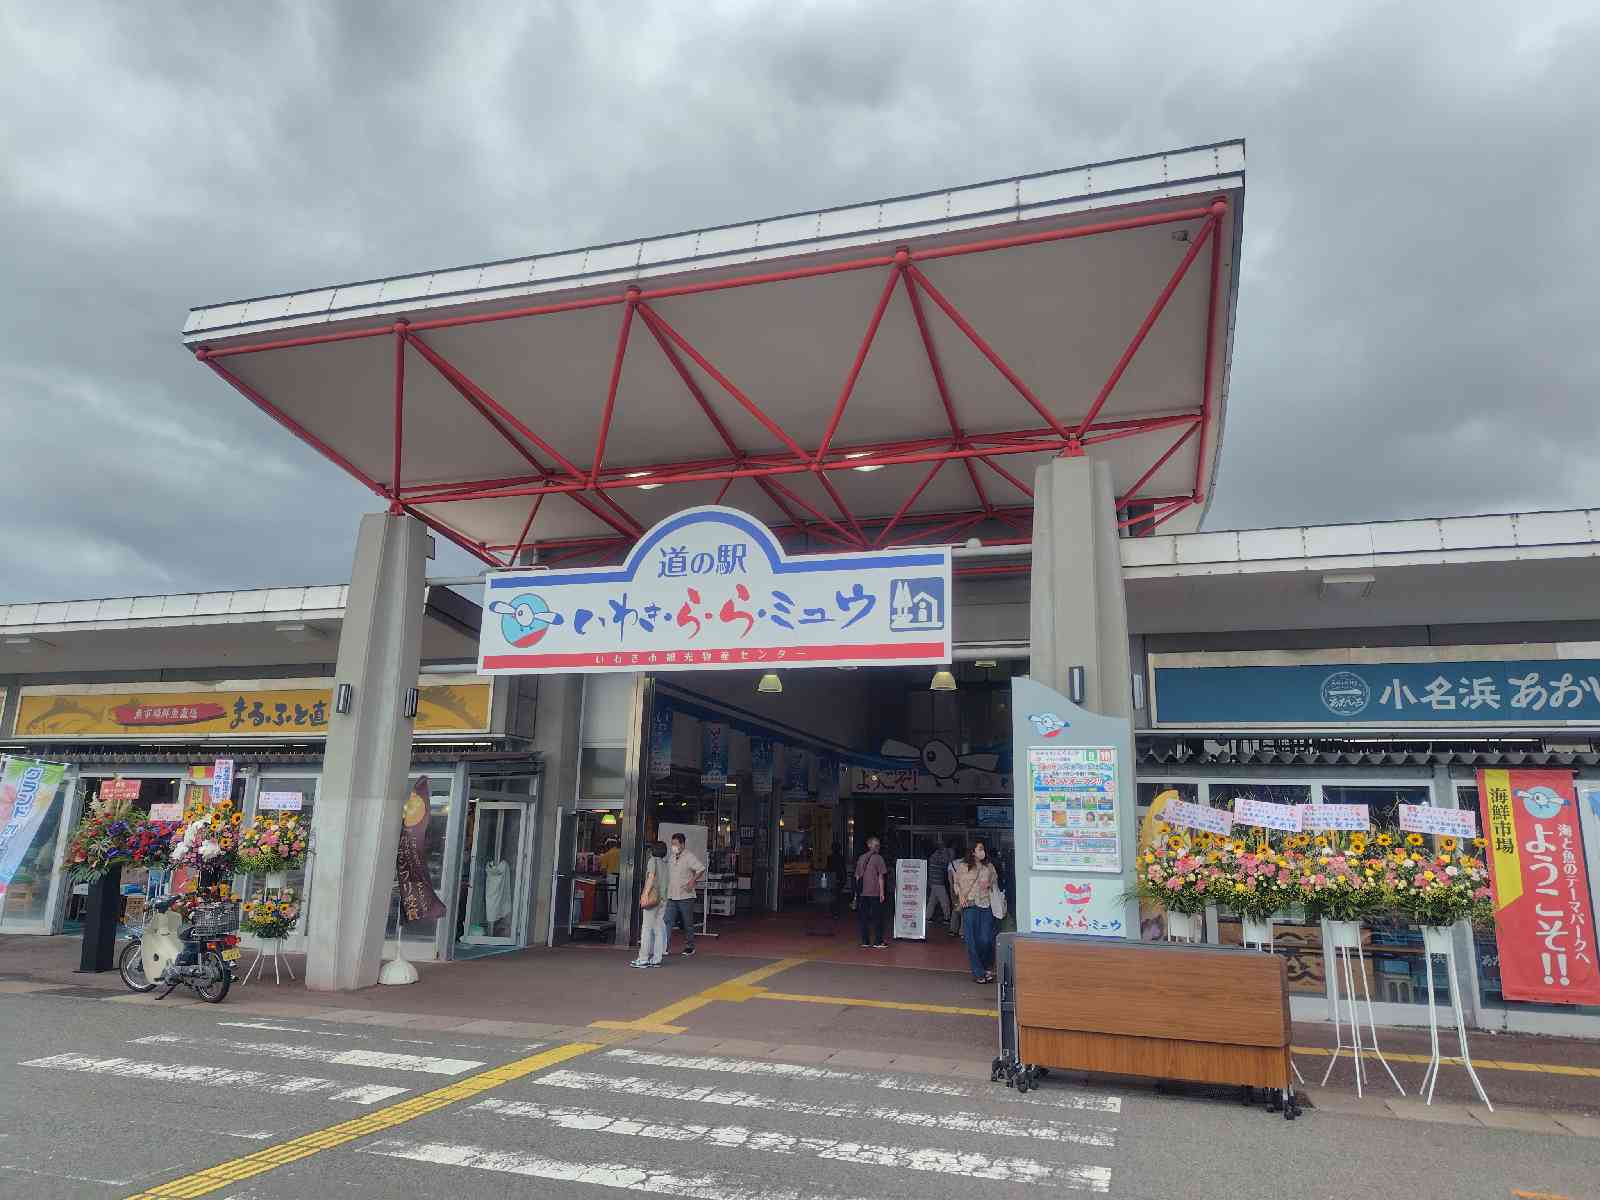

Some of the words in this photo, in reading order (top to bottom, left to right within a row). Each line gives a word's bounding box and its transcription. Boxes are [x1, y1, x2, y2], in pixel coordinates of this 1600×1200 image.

[657, 543, 747, 579] 道の駅
[1378, 675, 1501, 711] 小名浜
[1491, 787, 1514, 854] 海鮮市場
[1525, 823, 1570, 986] ようこそ!!
[1557, 823, 1591, 964] 海と魚のテーマパークへ
